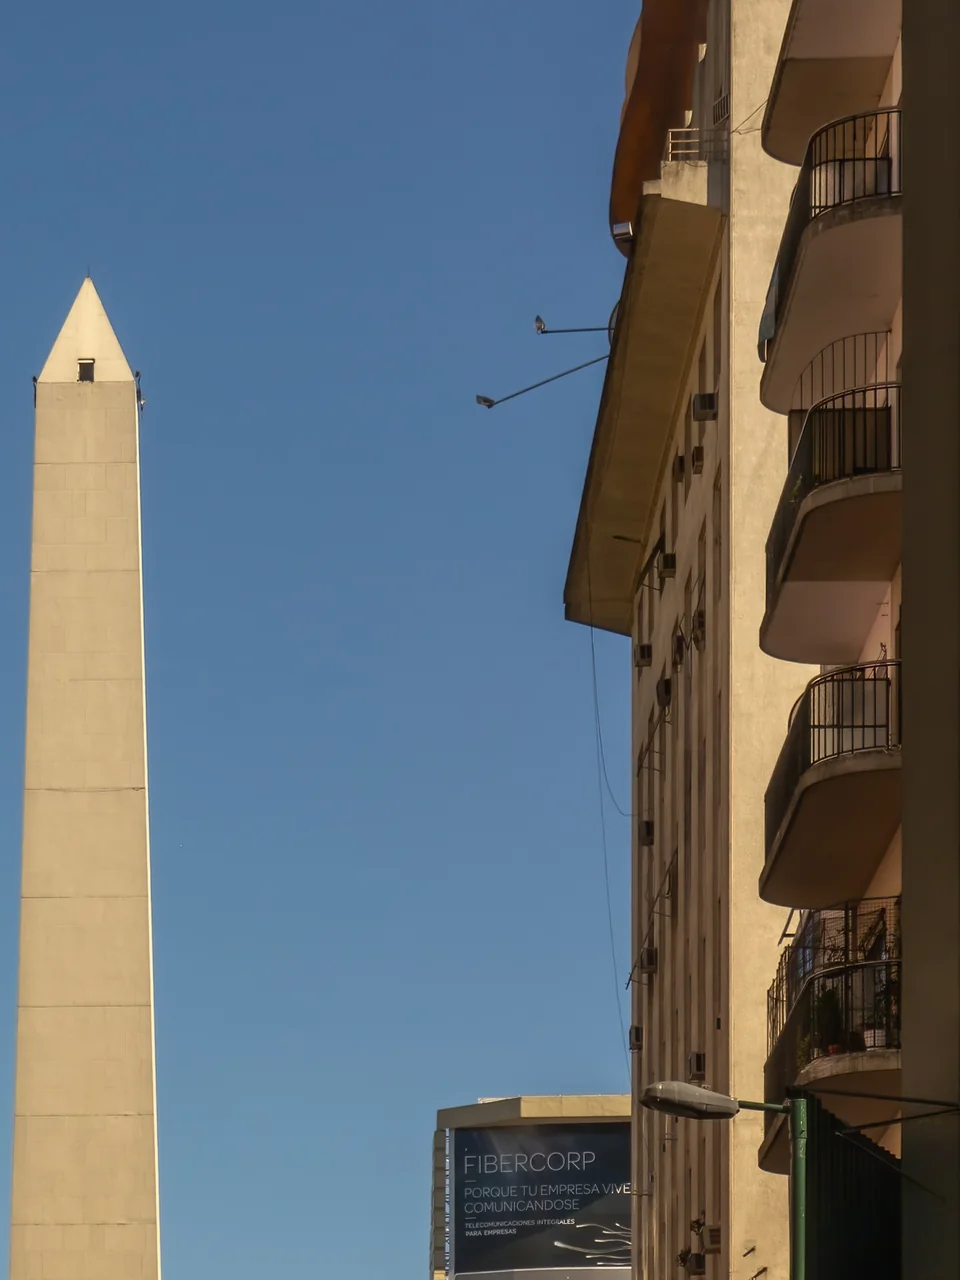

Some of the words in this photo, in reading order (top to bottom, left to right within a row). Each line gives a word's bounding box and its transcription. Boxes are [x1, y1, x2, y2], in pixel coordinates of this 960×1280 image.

[464, 1151, 596, 1175] FIBERCORP
[464, 1186, 518, 1199] PORQUE
[521, 1185, 538, 1197] TU
[540, 1183, 600, 1196] EMPRESA
[602, 1182, 631, 1194] VIVE
[464, 1199, 580, 1214] COMUNICANDOSE
[465, 1219, 535, 1229] TELECOMUNICACIONES
[537, 1218, 575, 1226] INTEGRALES
[465, 1229, 482, 1237] PARA
[483, 1228, 517, 1236] EMPRESAS
